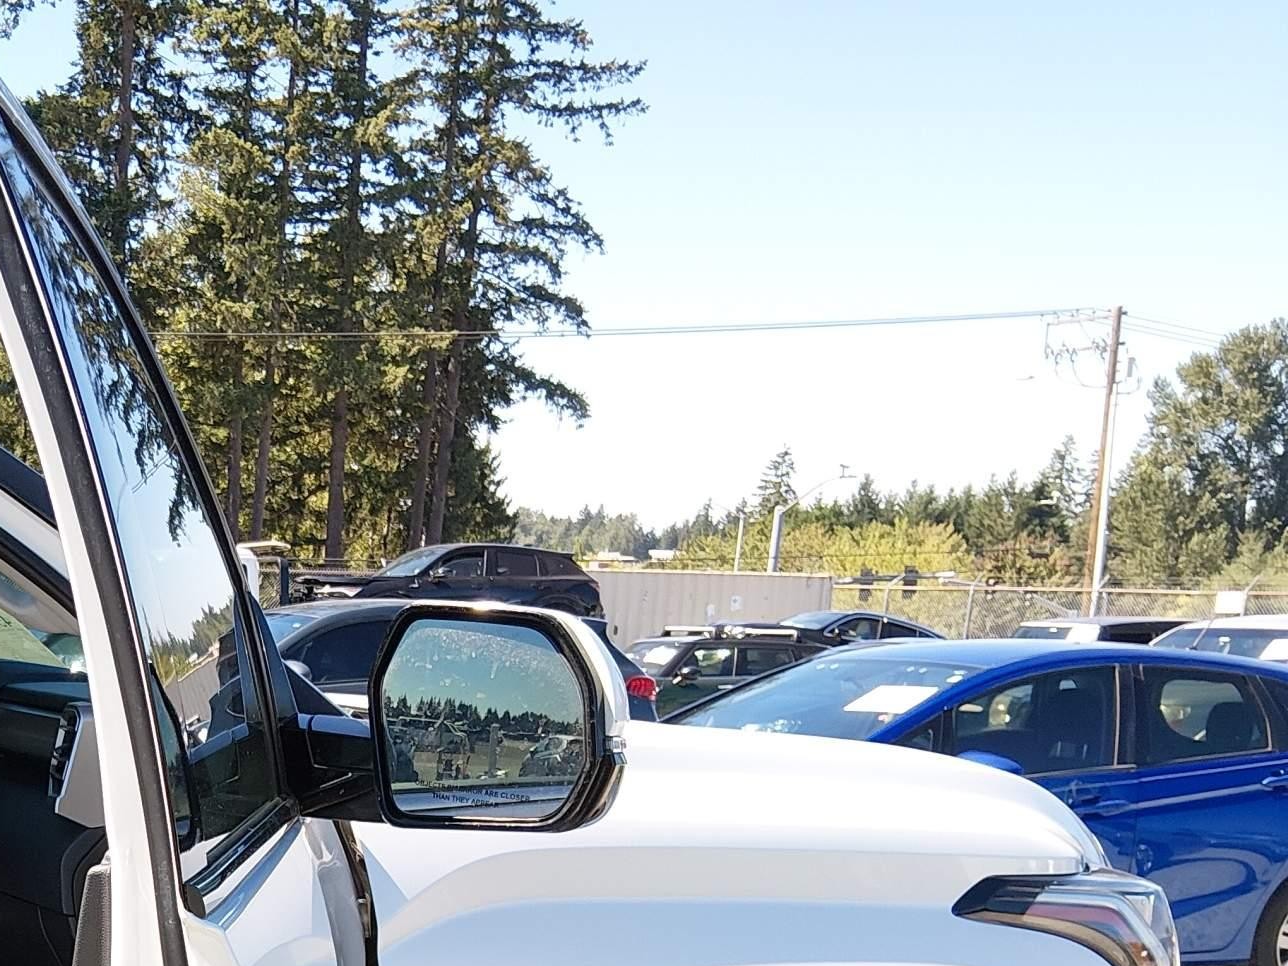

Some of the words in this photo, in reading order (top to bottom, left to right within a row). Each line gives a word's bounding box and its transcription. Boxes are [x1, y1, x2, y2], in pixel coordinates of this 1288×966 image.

[415, 780, 446, 791] OBJECTS
[484, 789, 499, 798] ARE
[500, 792, 531, 802] CLOSER
[432, 792, 450, 801] THAN
[451, 795, 470, 804] THEY
